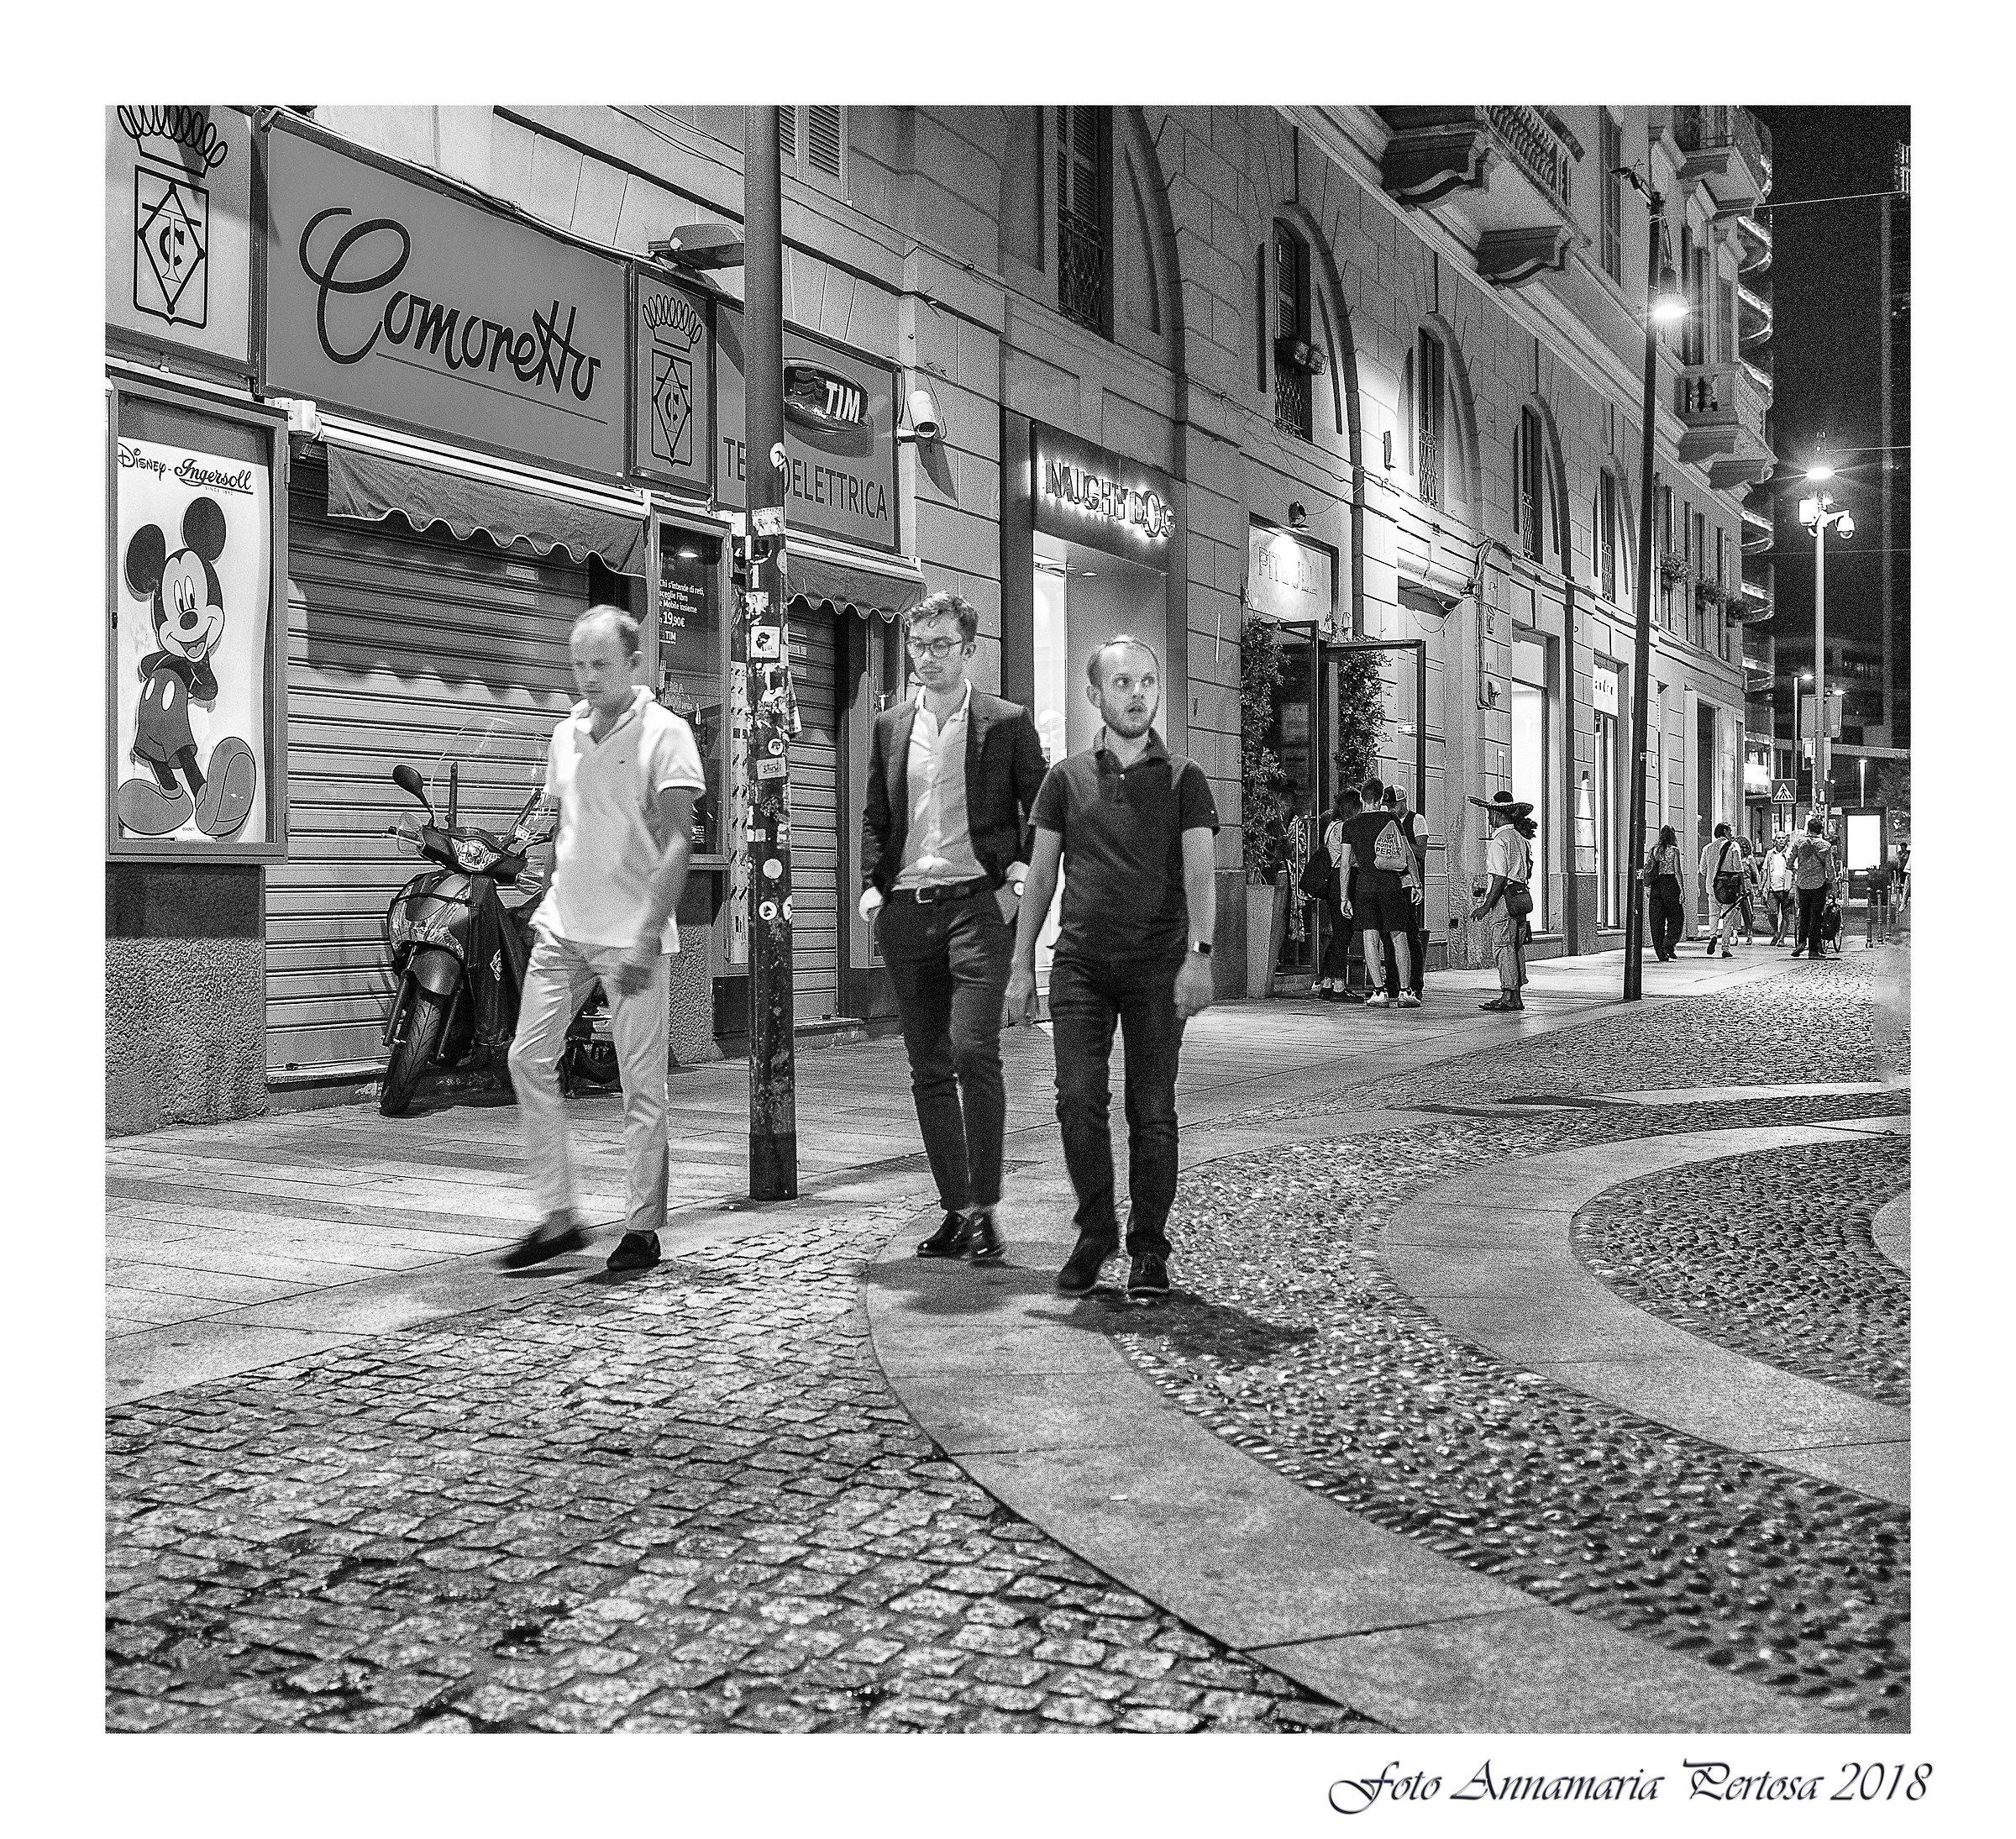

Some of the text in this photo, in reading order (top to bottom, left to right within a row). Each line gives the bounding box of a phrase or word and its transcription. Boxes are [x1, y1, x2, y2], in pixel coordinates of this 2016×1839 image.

[298, 207, 602, 402] Comoretto
[825, 380, 860, 423] TIM
[174, 458, 252, 491] Ingersoll
[1046, 460, 1176, 539] NAUGHTY DOG
[659, 579, 668, 588] Chi
[690, 585, 695, 593] di
[659, 590, 676, 601] sceglie
[664, 599, 680, 610] Mobile
[680, 602, 698, 613] insieme
[664, 611, 685, 628] 19,90€
[665, 630, 677, 641] TIM
